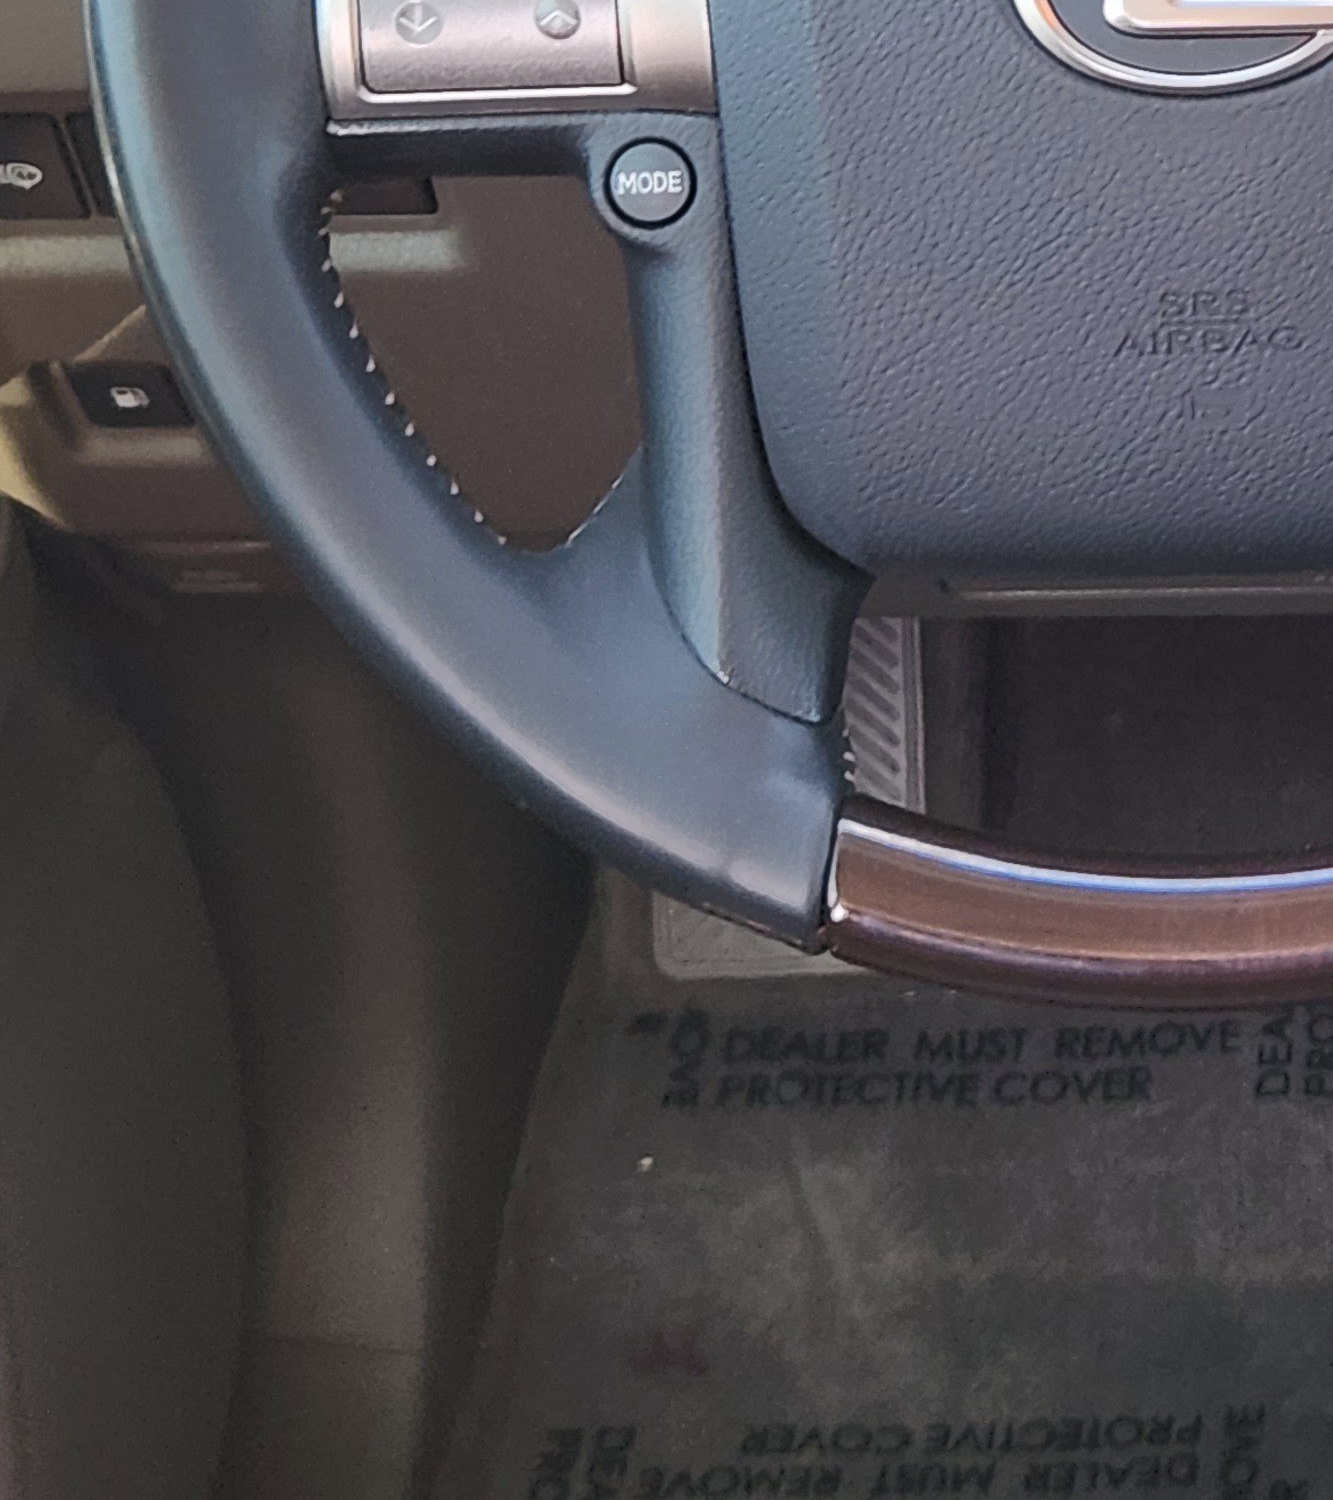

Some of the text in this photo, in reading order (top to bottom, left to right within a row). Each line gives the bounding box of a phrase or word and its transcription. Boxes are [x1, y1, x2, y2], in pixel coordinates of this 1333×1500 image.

[617, 170, 683, 194] MODE
[723, 1020, 1242, 1064] DEALER MUST REMOVE
[714, 1065, 1154, 1107] PROTECTIVE COVER
[741, 1421, 913, 1457] COVER
[925, 1411, 1205, 1454] PROTECTIVE
